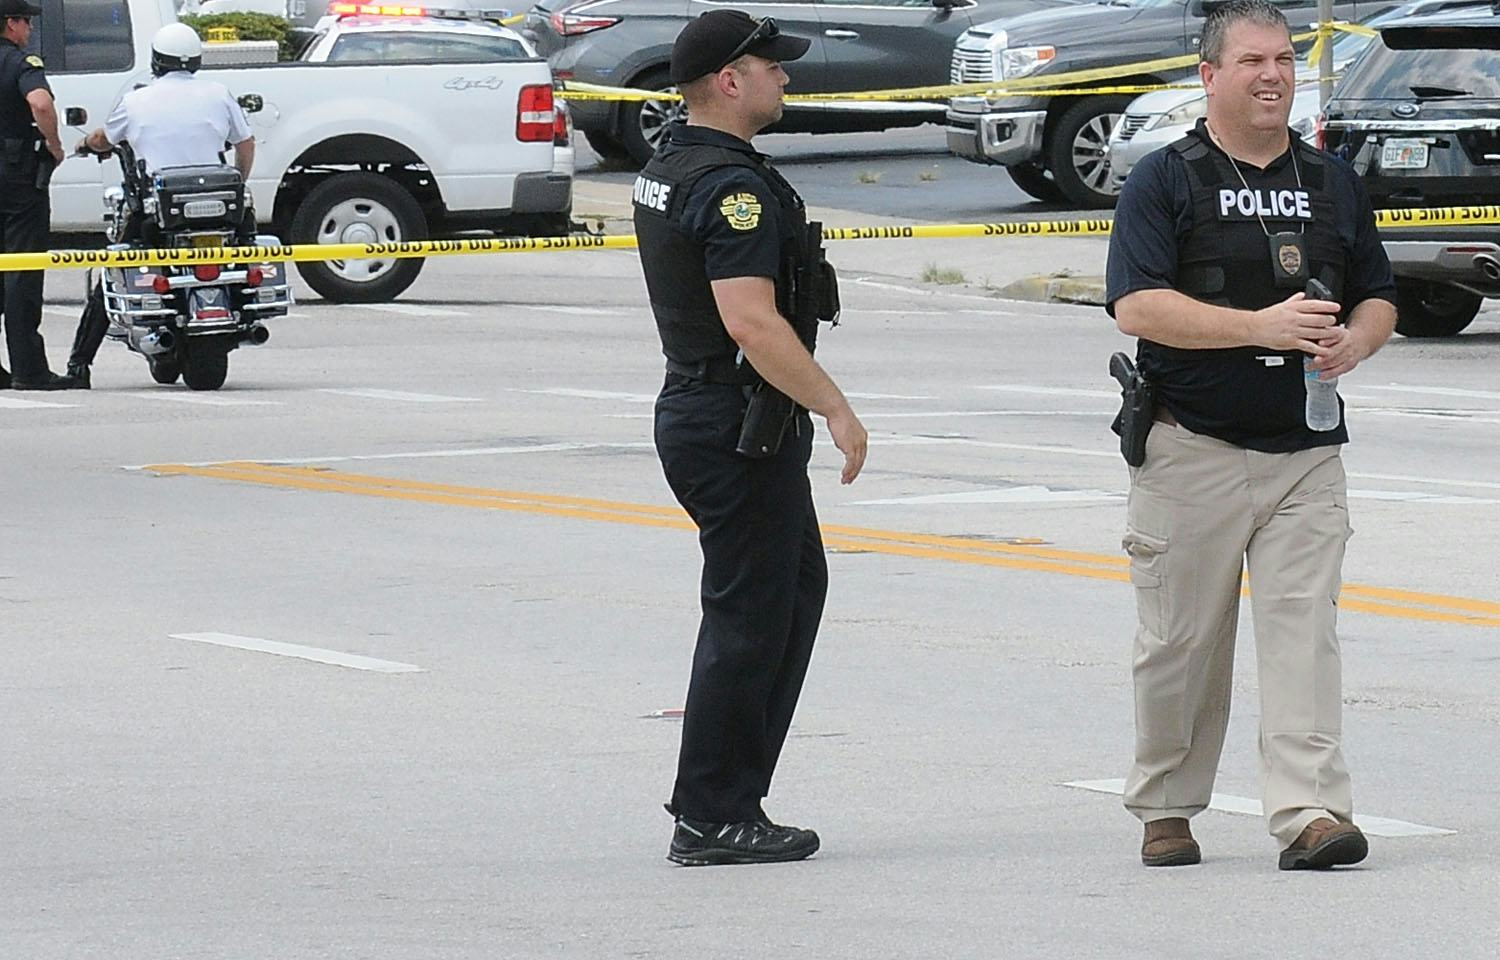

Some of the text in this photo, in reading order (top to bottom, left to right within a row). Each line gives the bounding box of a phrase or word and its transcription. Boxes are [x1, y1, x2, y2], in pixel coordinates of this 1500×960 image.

[443, 76, 503, 90] 4x4
[634, 176, 671, 211] OLICE
[1219, 189, 1312, 218] POLICE
